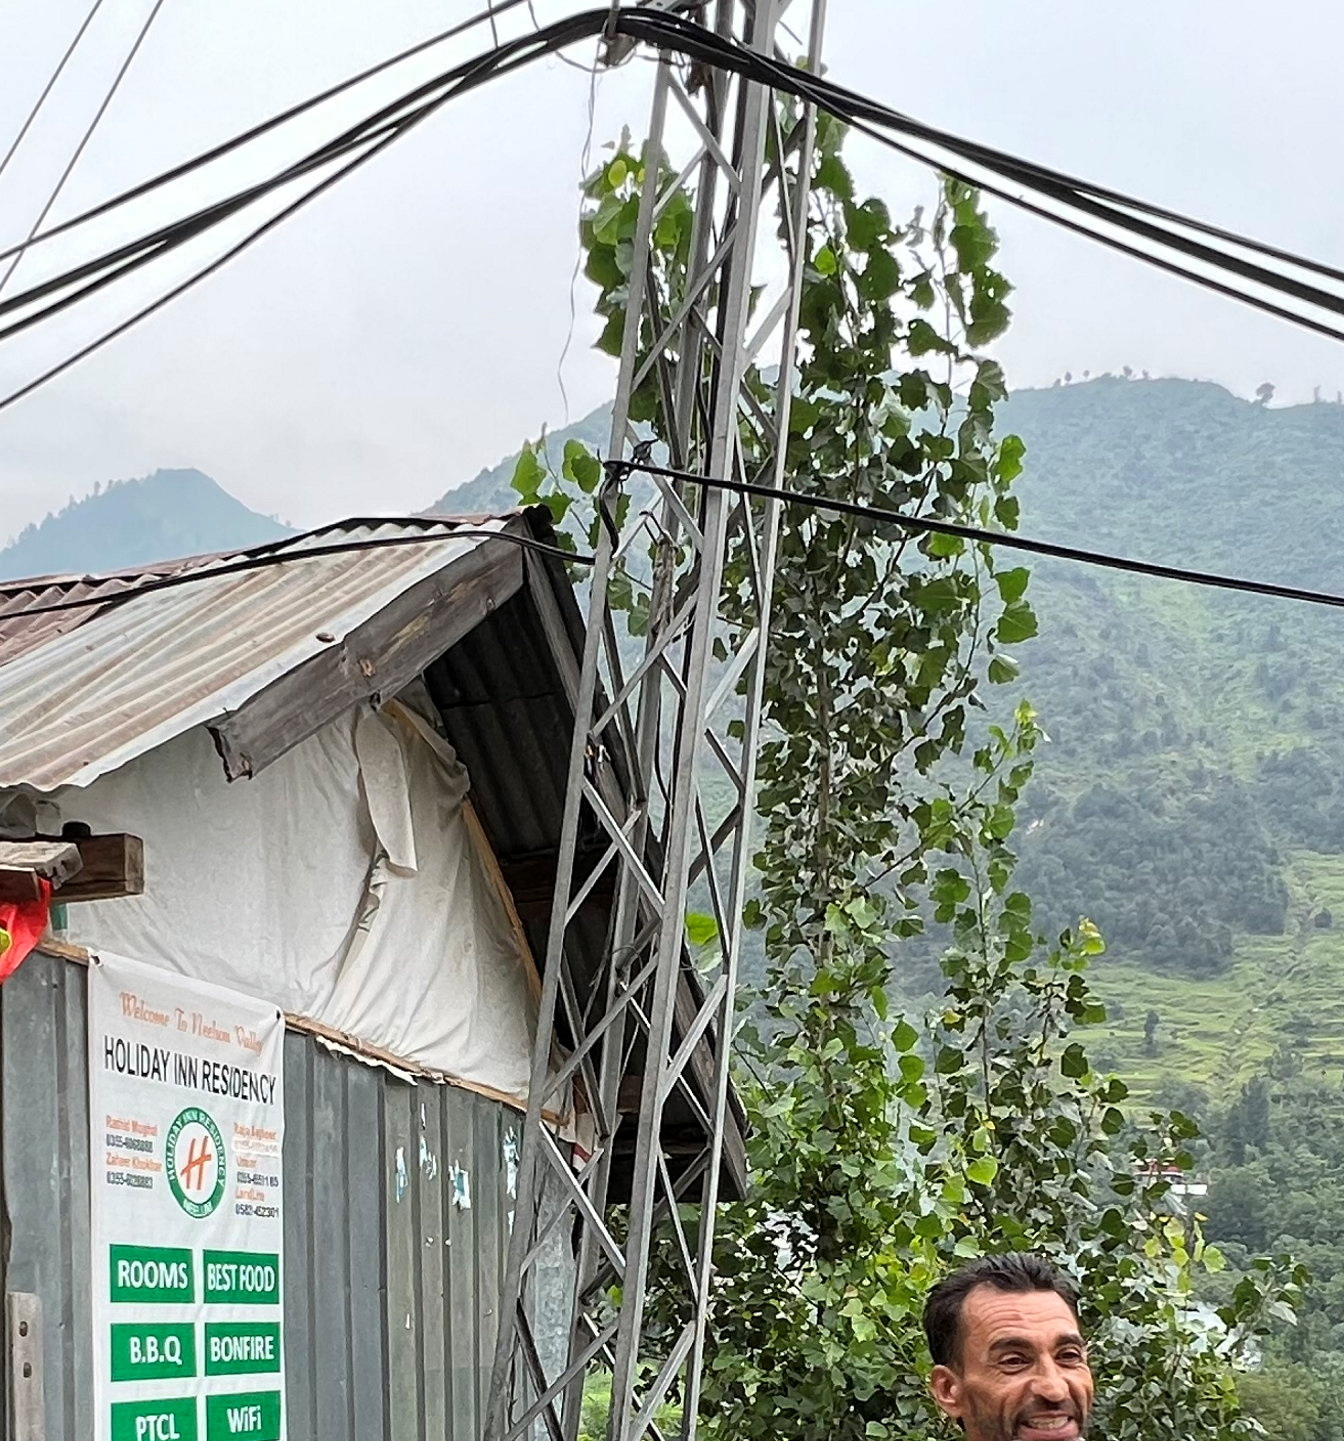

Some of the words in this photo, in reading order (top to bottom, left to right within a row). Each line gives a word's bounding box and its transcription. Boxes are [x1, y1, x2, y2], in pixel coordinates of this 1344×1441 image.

[119, 991, 170, 1028] Welcome
[174, 1007, 188, 1033] To
[191, 1011, 231, 1043] Neelum
[104, 1034, 171, 1083] HOLIDAY
[174, 1052, 198, 1089] INN
[202, 1059, 277, 1105] RESIDENCY
[117, 1259, 188, 1290] ROOMS
[207, 1263, 238, 1292] BEST
[239, 1264, 275, 1292] FOOD
[129, 1335, 183, 1365] B.B.Q
[210, 1335, 275, 1362] BONFIRE
[226, 1405, 262, 1433] WiFi
